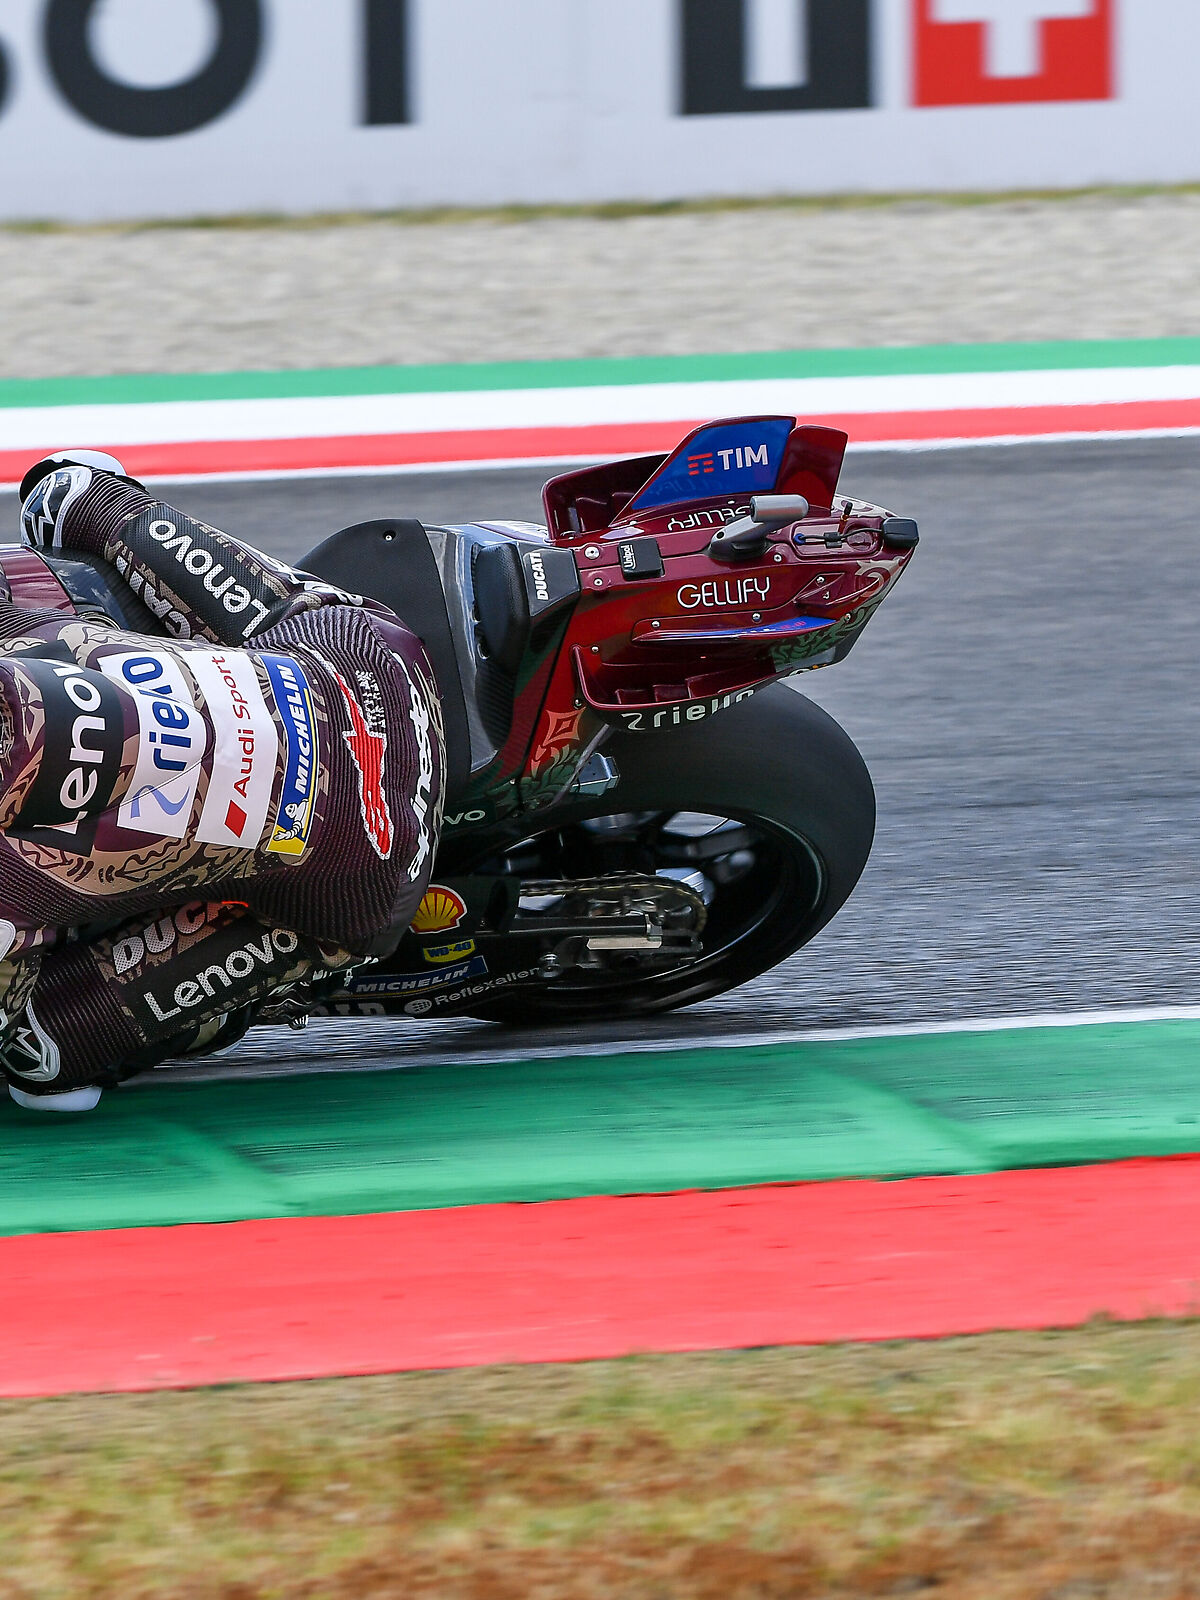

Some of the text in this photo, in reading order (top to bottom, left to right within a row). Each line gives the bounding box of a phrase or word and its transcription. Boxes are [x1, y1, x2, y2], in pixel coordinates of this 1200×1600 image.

[717, 444, 769, 471] TIM
[149, 520, 271, 638] Lenovo
[536, 551, 550, 601] DUCATI
[623, 544, 634, 570] Unipol
[676, 576, 771, 609] GELLIFY
[211, 655, 255, 799] Audi Sport
[276, 664, 311, 795] MICHELIN
[33, 667, 106, 835] Lenov
[427, 942, 471, 959] WD-40
[144, 928, 298, 1022] Lenovo
[356, 965, 470, 993] MICHELIN
[434, 967, 540, 1007] Reflexallen
